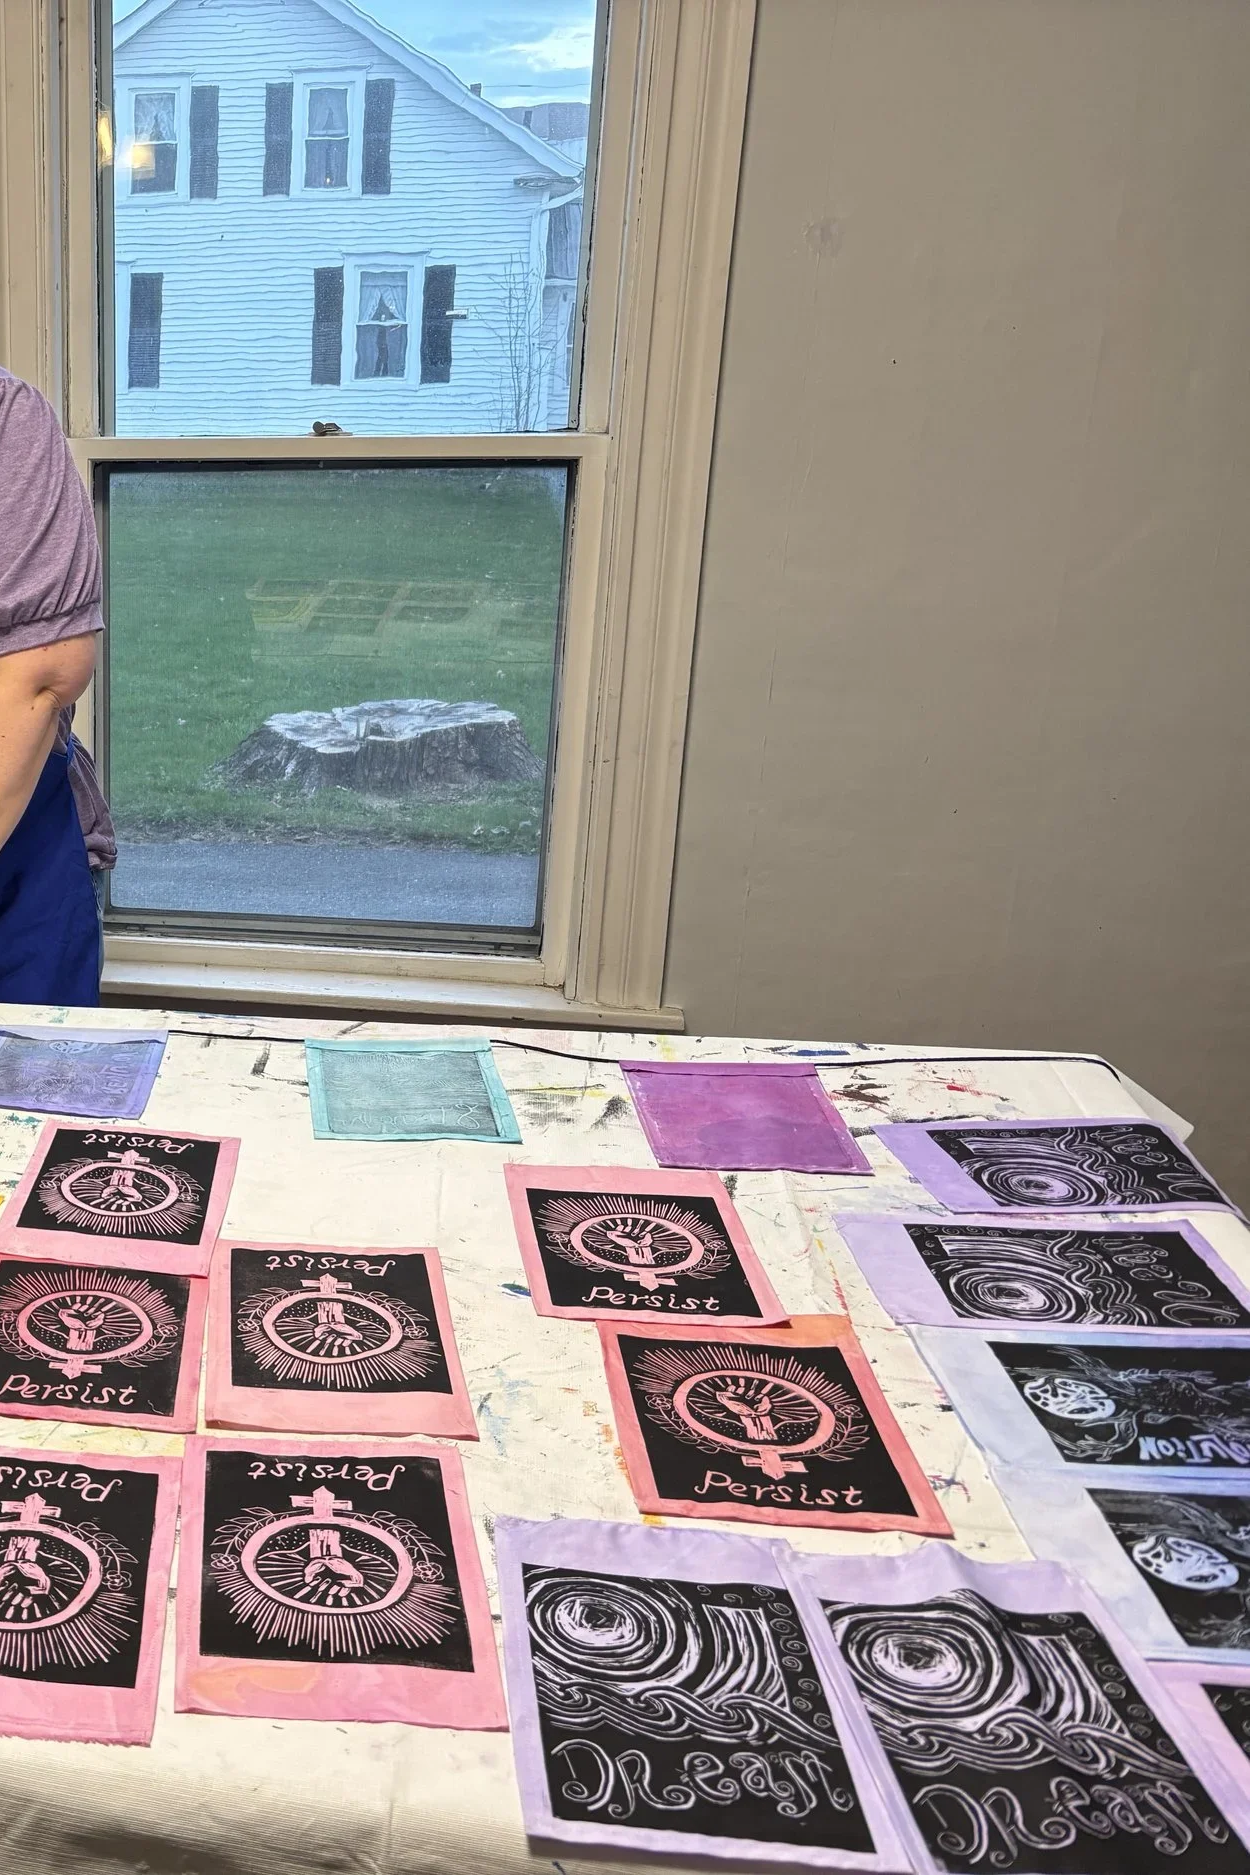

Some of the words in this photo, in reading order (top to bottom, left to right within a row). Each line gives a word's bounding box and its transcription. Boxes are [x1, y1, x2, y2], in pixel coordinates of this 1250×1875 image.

[82, 1131, 195, 1155] Persist
[264, 1254, 396, 1277] Persist
[582, 1285, 721, 1313] Persist
[248, 1461, 407, 1492] Persist
[694, 1469, 865, 1507] Persist
